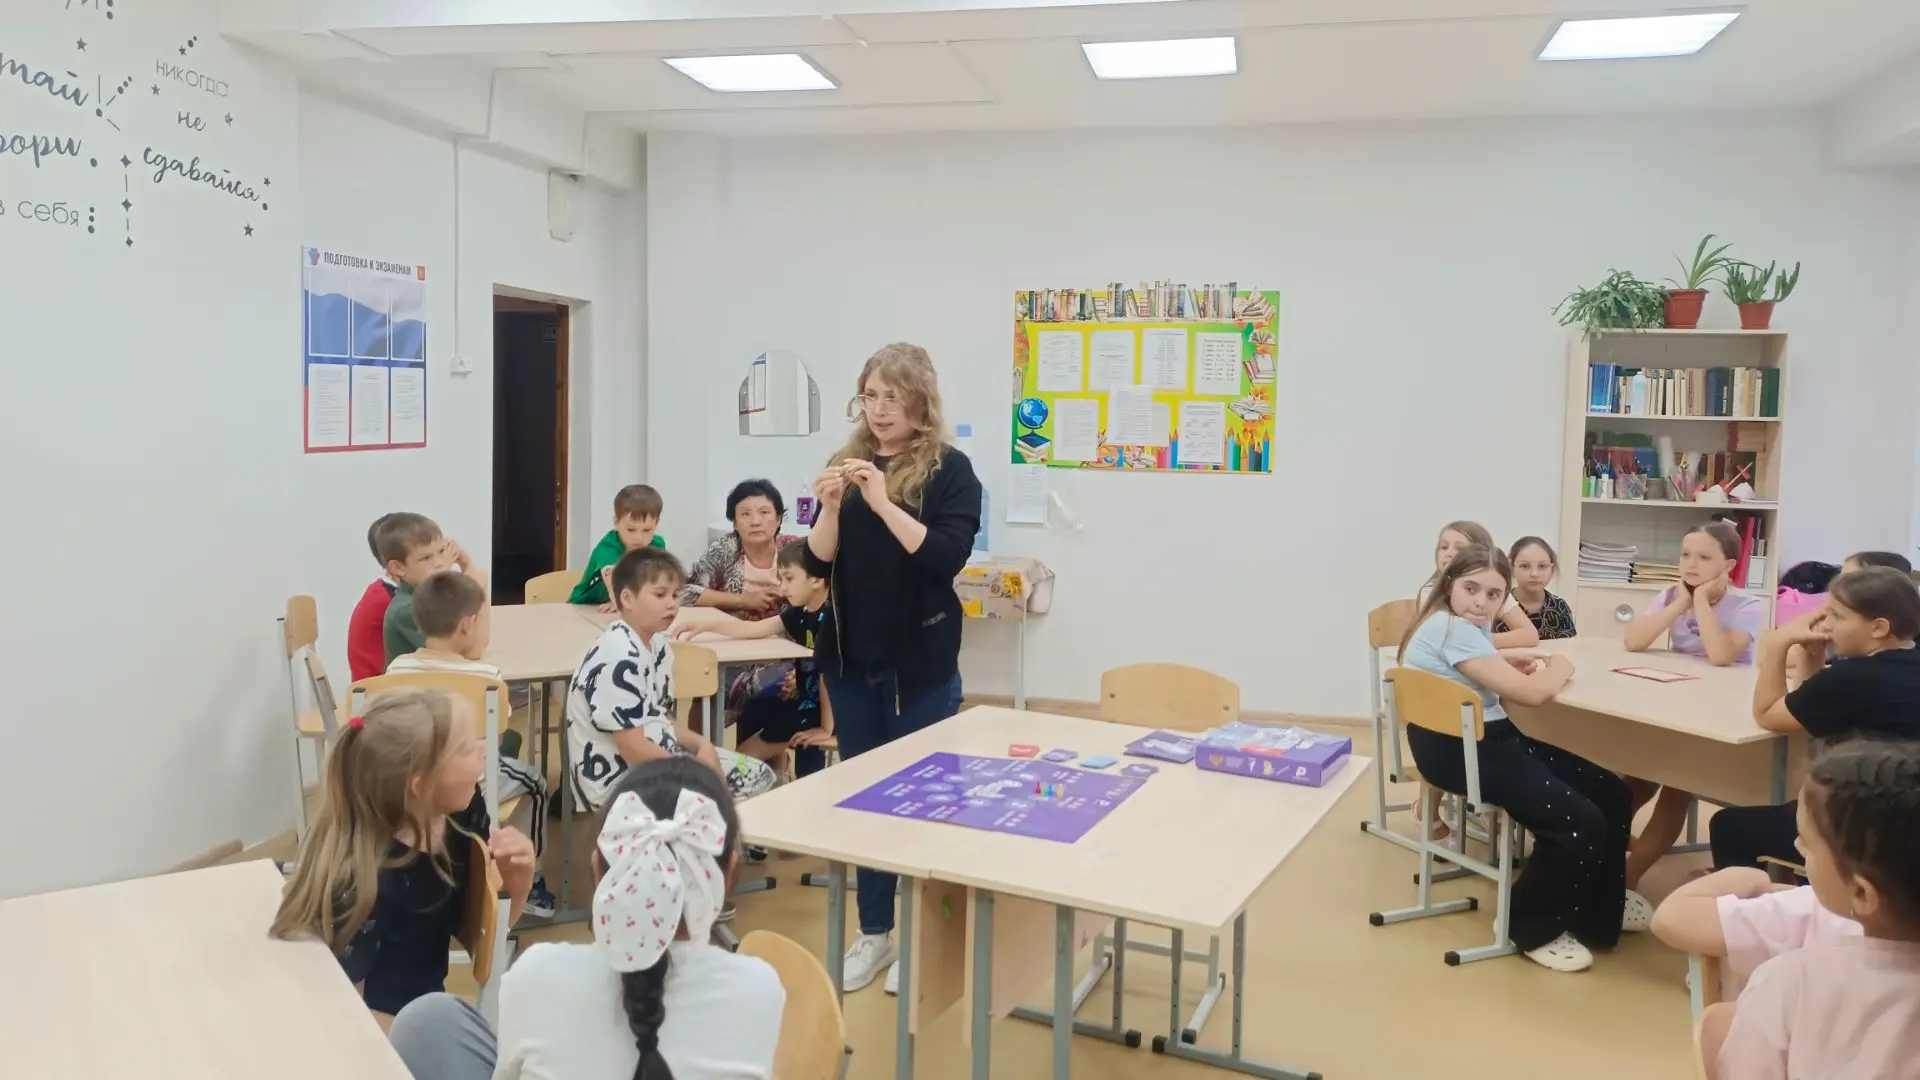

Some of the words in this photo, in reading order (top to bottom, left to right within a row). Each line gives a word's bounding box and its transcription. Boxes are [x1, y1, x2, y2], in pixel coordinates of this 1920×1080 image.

[143, 147, 260, 201] сдавайся
[324, 251, 368, 269] ПОДГОТОВКА
[369, 259, 375, 270] К
[375, 260, 412, 276] ЭКЗАМЕНАМ
